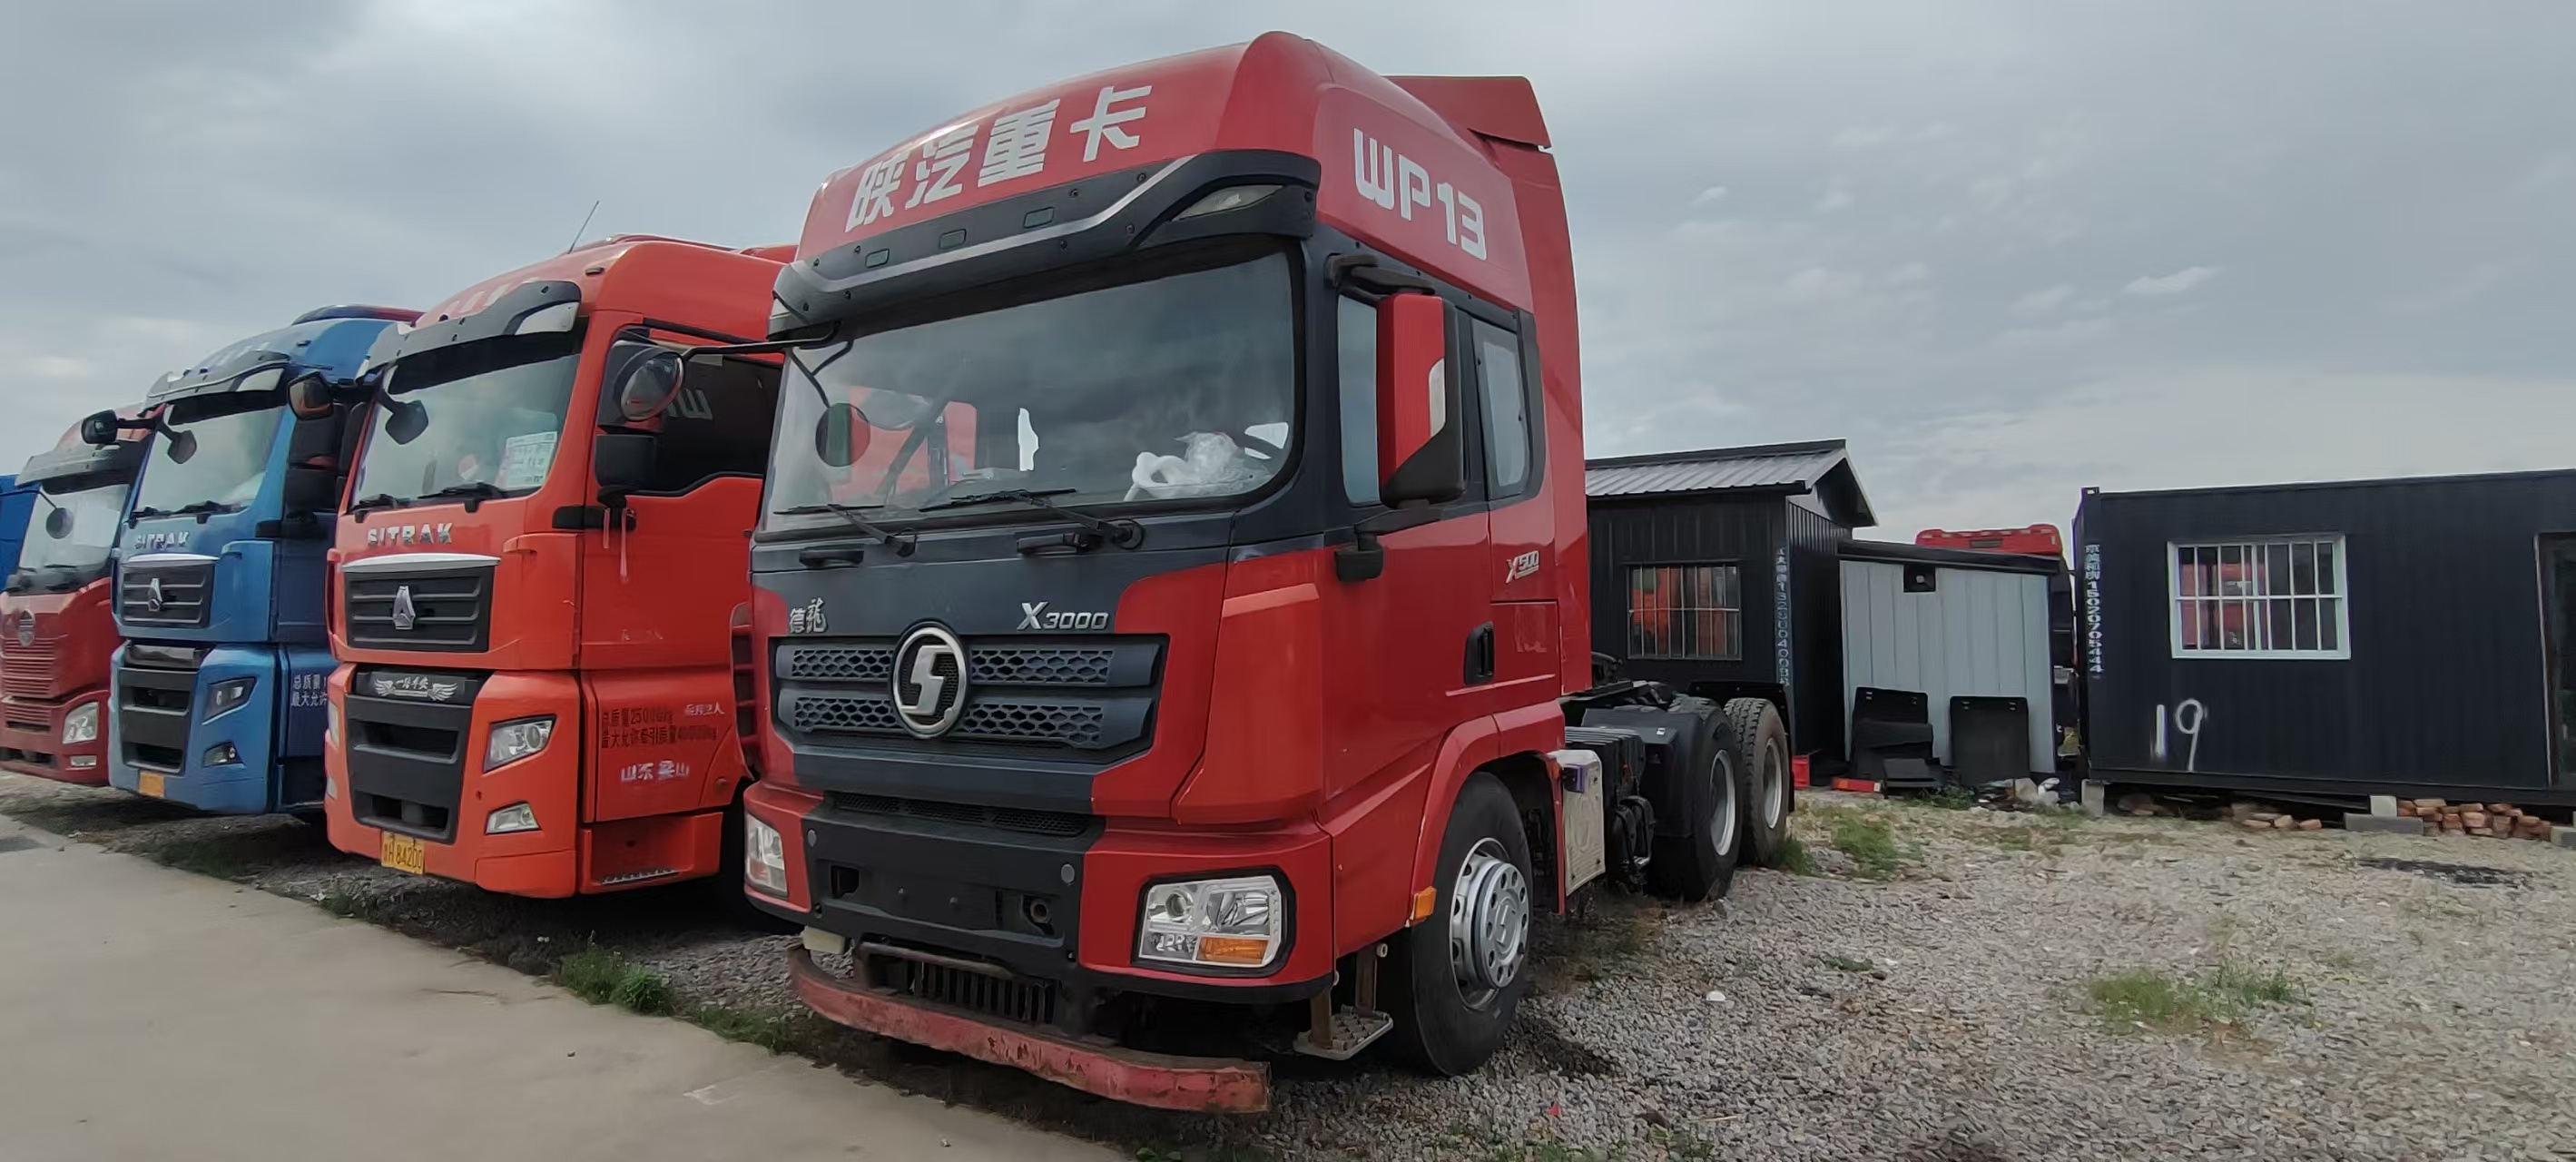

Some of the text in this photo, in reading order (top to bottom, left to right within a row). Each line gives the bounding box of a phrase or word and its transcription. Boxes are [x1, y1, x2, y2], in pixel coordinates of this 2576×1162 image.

[845, 84, 1153, 233] 陕汽重卡
[1353, 127, 1488, 261] WP13
[366, 522, 453, 546] SITRAK
[1016, 601, 1110, 631] X3000
[2154, 697, 2206, 773] 19
